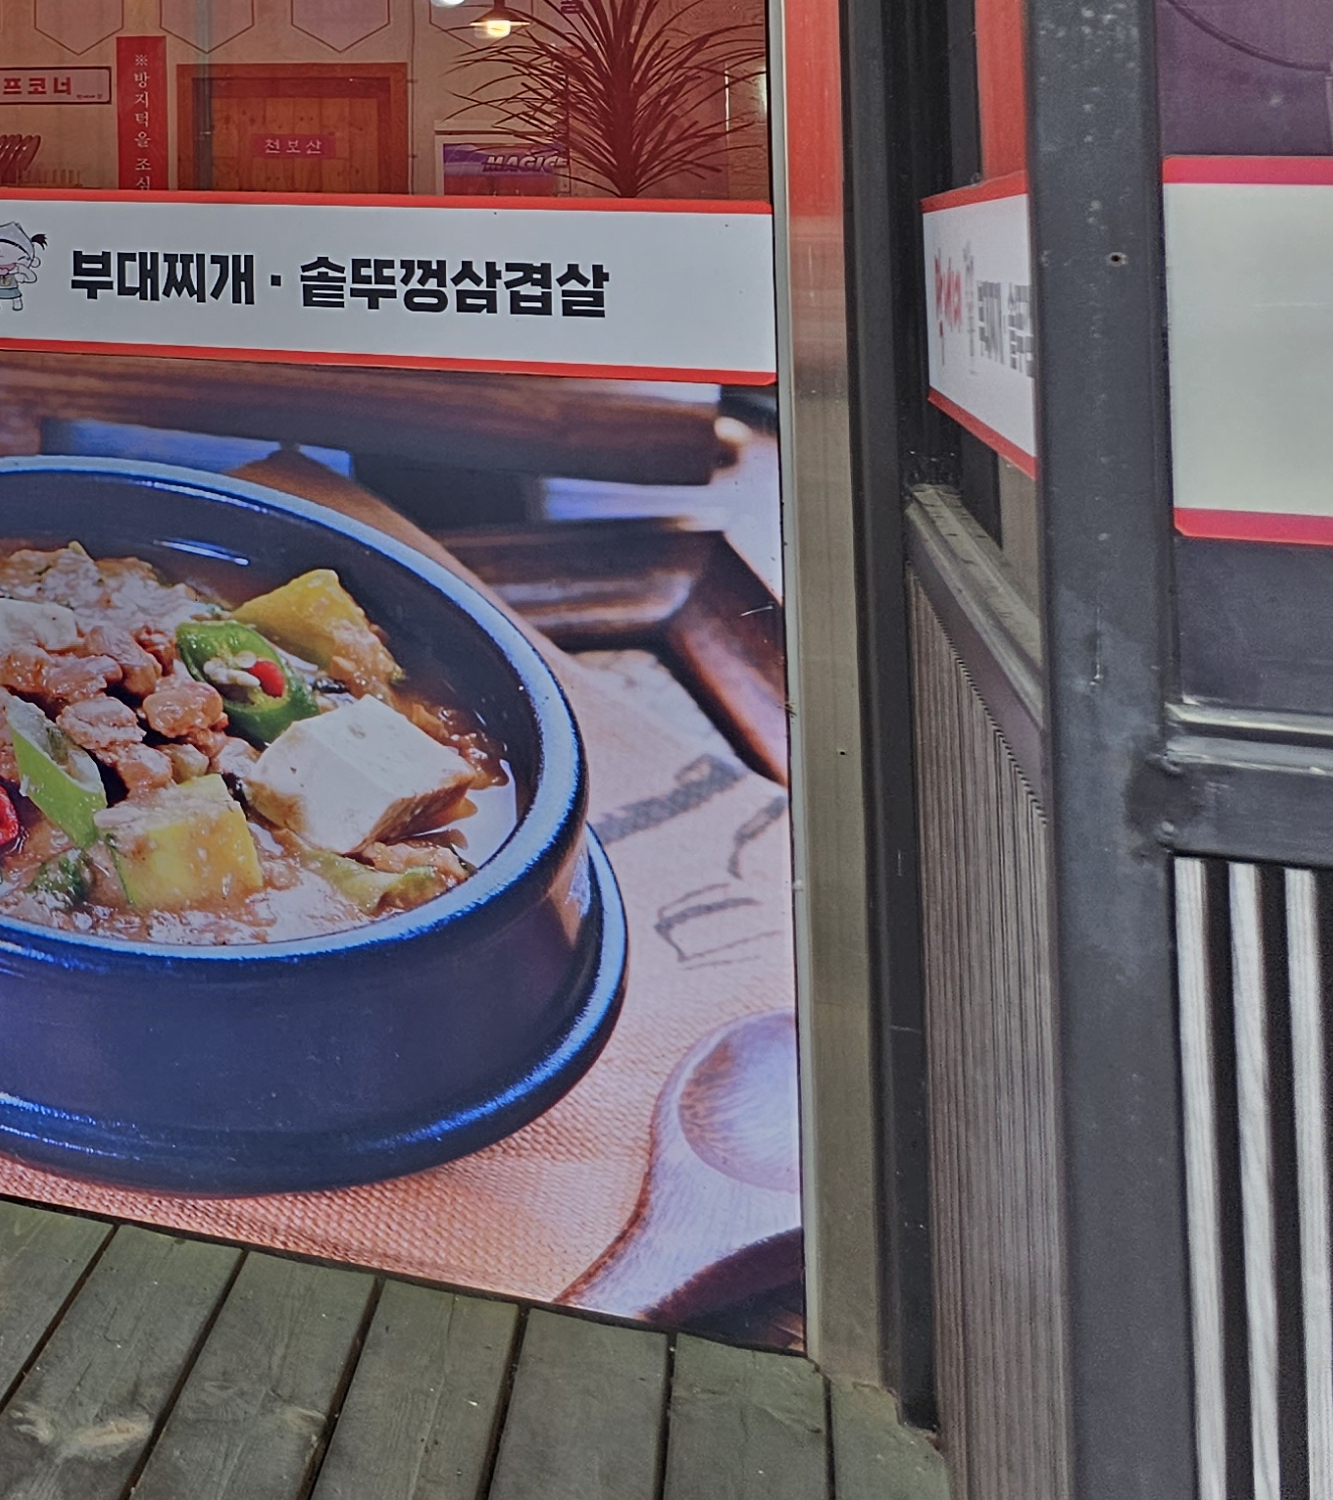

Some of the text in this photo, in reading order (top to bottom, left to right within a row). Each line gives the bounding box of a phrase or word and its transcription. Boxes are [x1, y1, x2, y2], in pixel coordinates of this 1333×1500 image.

[263, 138, 322, 155] 천보산
[70, 250, 256, 306] 부대찌개
[300, 256, 611, 318] 솥뚜껑삼겹살
